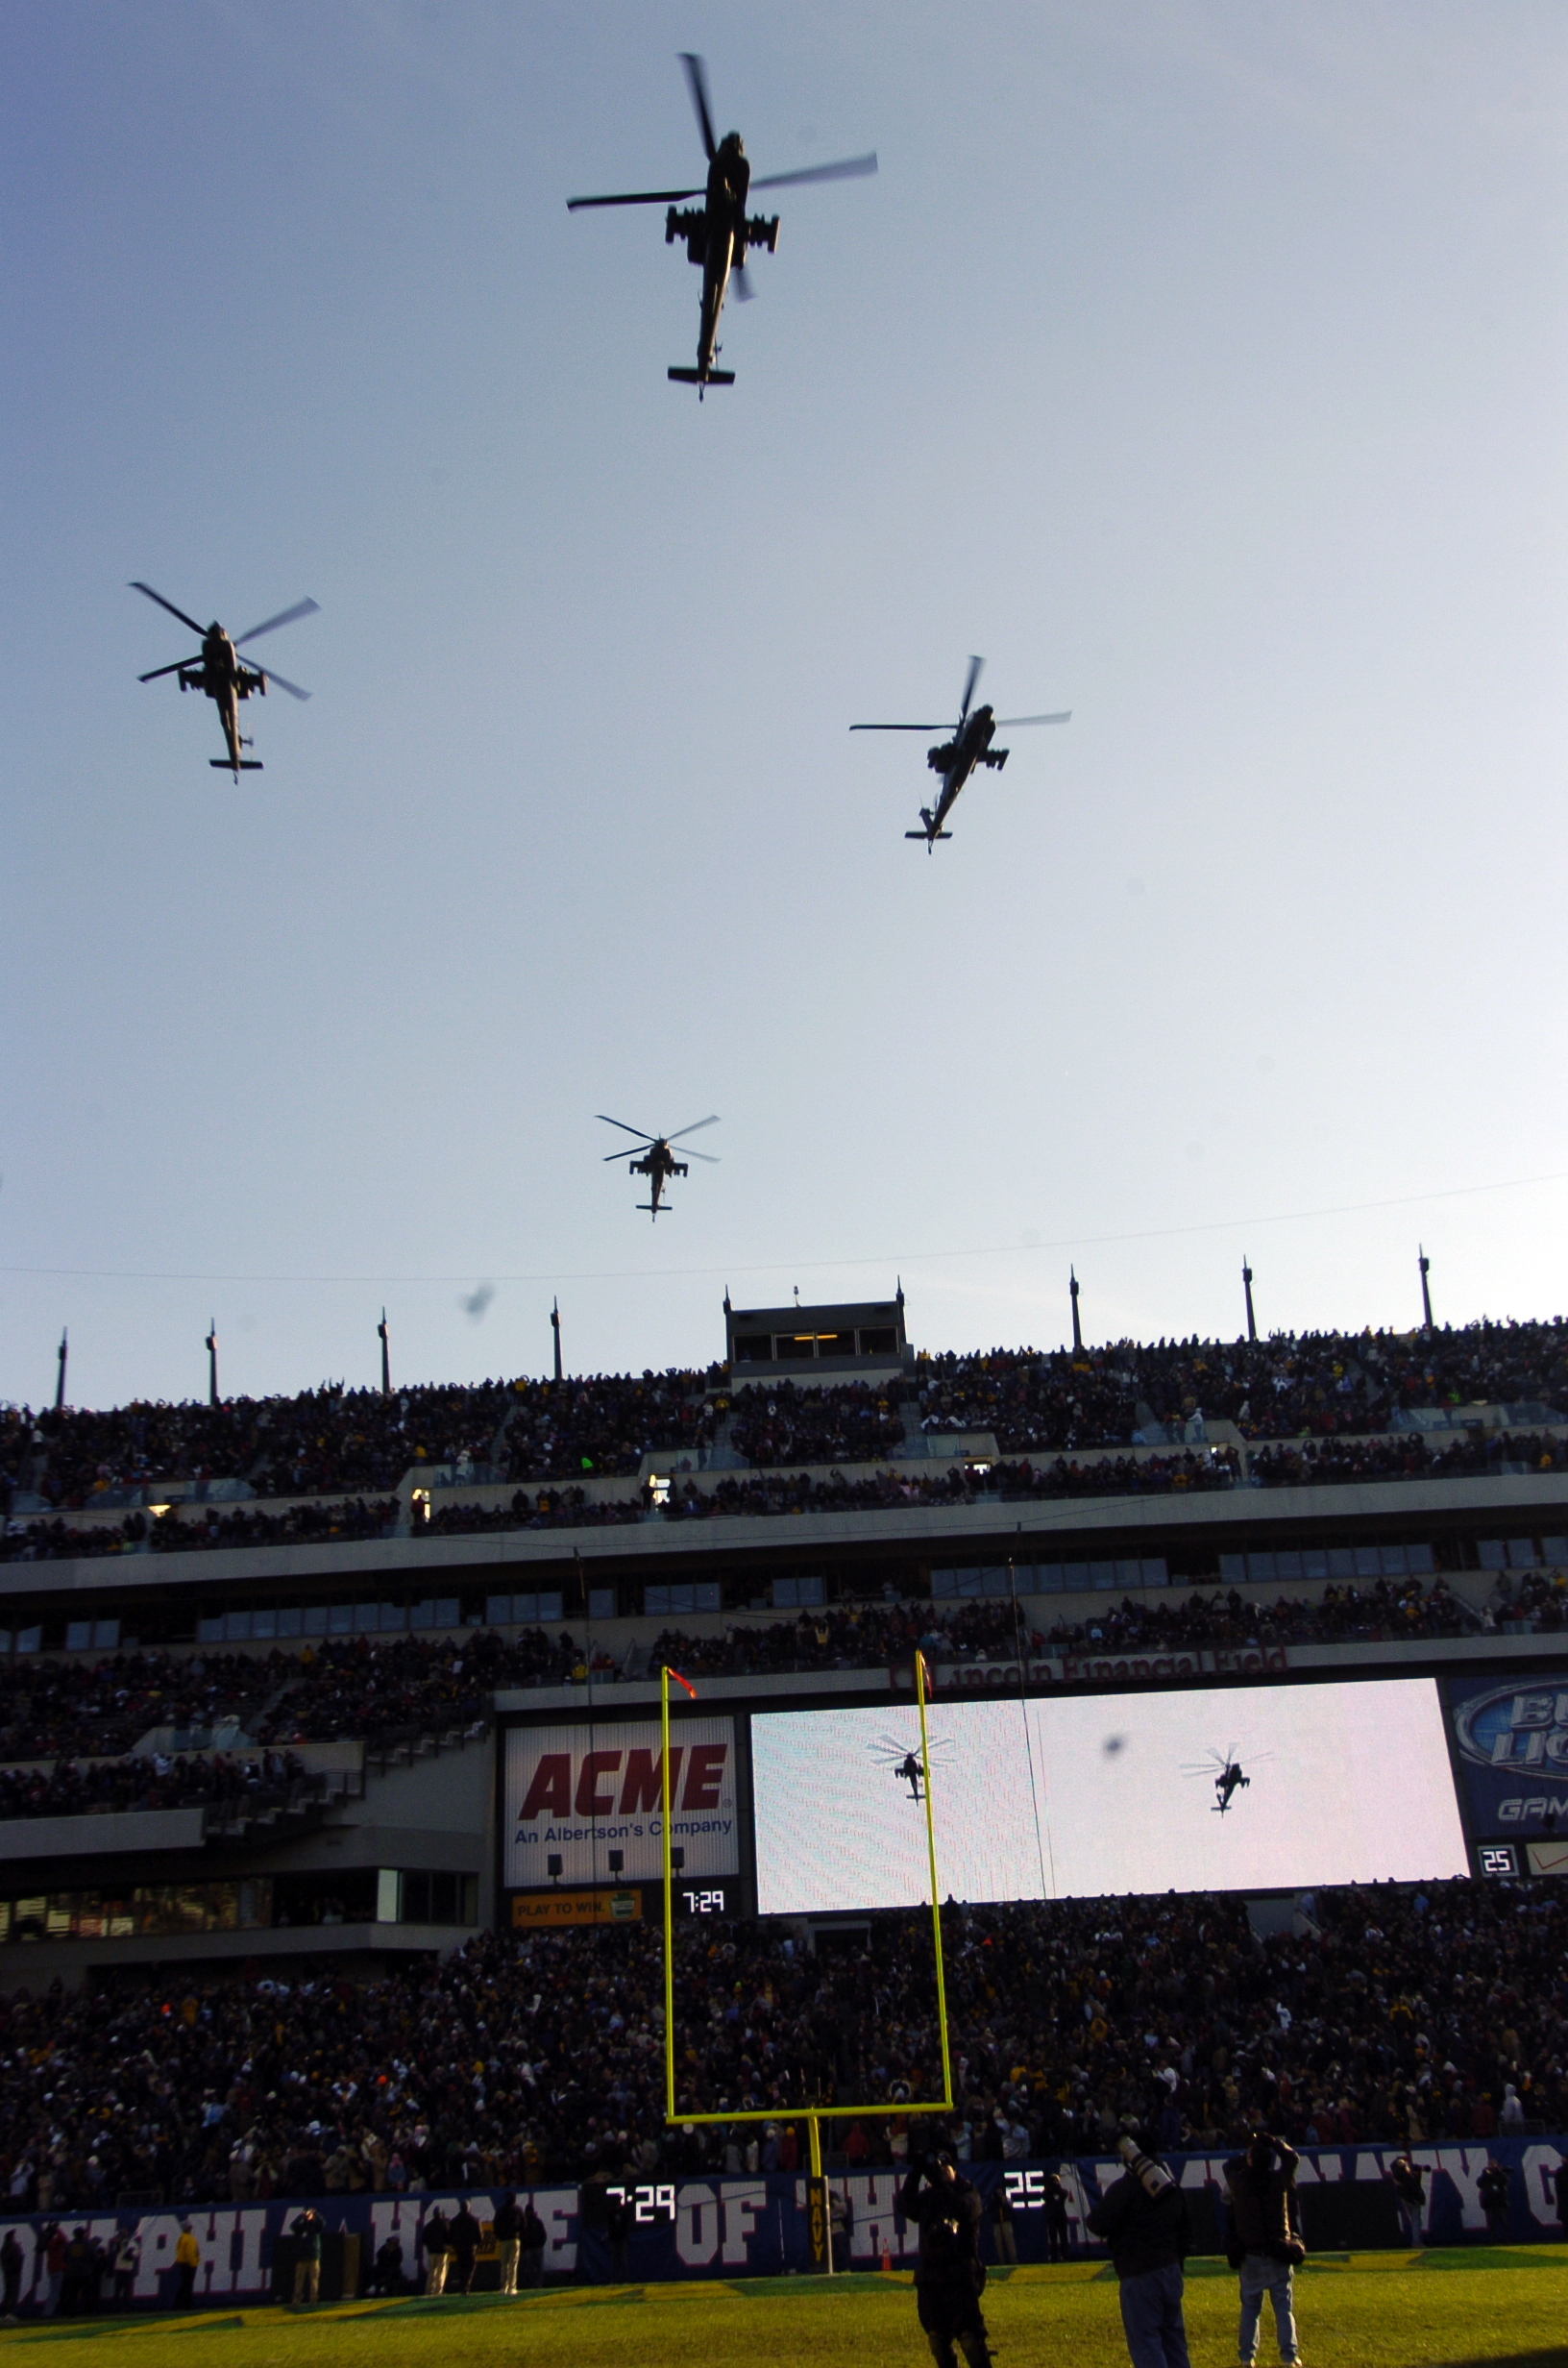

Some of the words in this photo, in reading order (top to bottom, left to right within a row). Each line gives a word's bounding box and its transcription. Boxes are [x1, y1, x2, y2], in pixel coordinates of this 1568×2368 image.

[930, 1658, 1054, 1690] Lincoln
[1063, 1649, 1205, 1683] Financial
[1213, 1643, 1289, 1675] Field
[517, 1743, 728, 1820] ACME
[514, 1829, 538, 1843] An
[544, 1822, 643, 1842] Albertson's
[1482, 1850, 1511, 1872] 25
[518, 1904, 551, 1916] PLAY
[554, 1903, 572, 1913] TO
[682, 1890, 724, 1912] 7:29
[1003, 2169, 1045, 2208] 25
[675, 2180, 768, 2267] OF
[809, 2187, 823, 2262] NAVY
